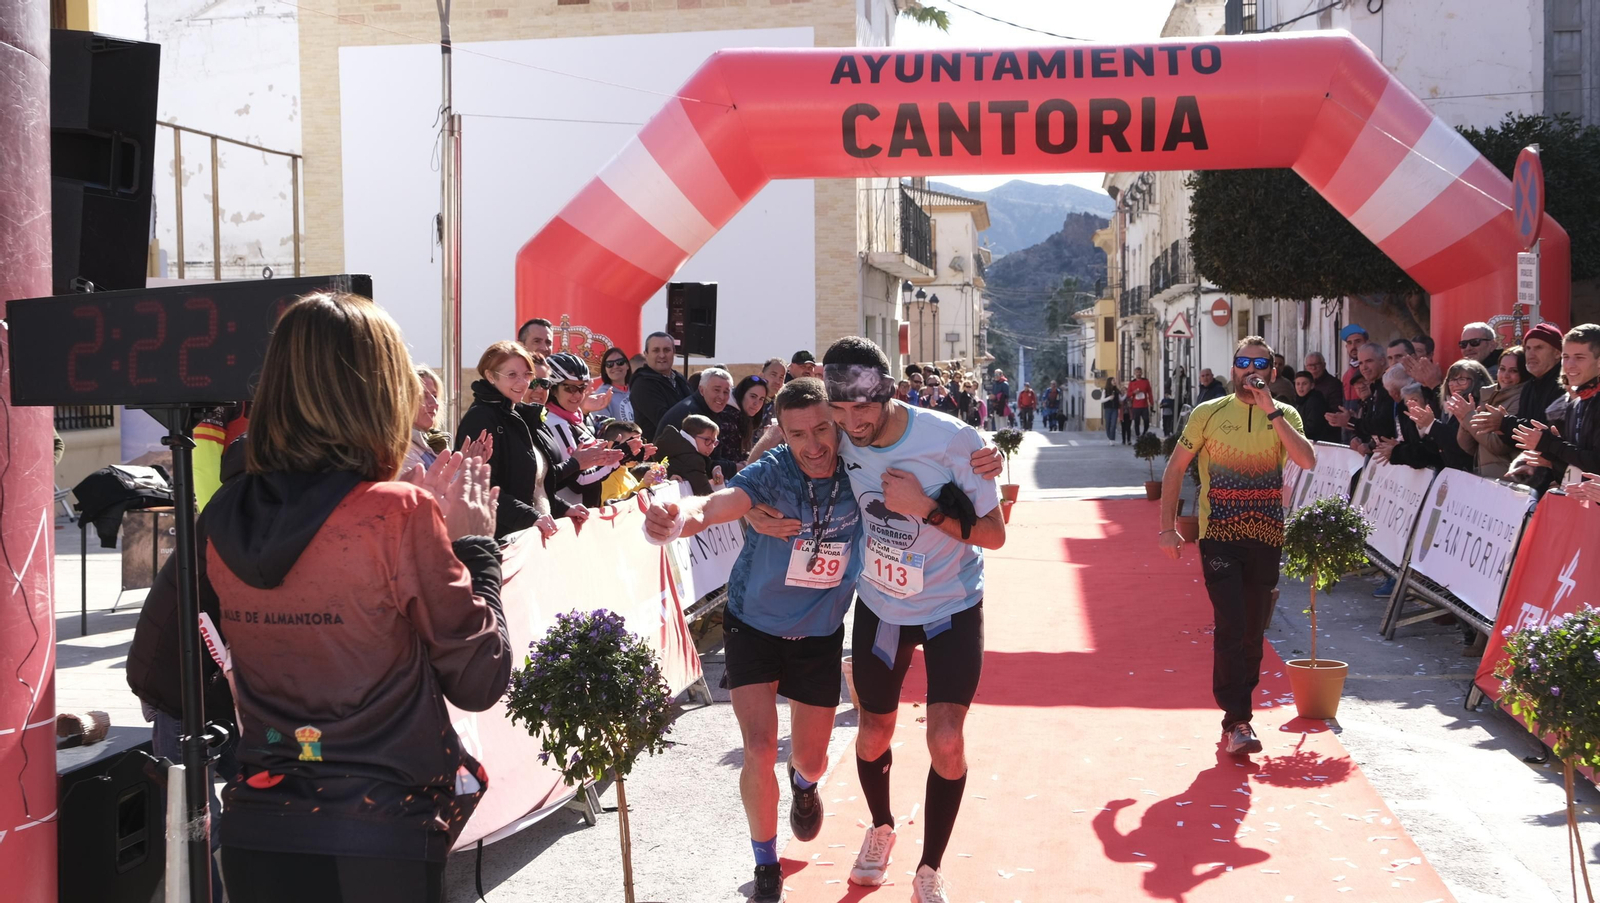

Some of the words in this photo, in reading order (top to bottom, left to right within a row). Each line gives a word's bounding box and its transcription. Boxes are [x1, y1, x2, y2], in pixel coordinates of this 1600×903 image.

[830, 44, 1222, 84] AYUNTAMIENTO
[841, 95, 1209, 159] CANTORIA
[876, 528, 913, 541] CARRASCA
[1446, 500, 1504, 537] AYUNTAMIENTO
[1503, 523, 1515, 543] DE
[812, 547, 840, 556] PLVORA
[1433, 519, 1508, 585] CANTORIA
[874, 558, 908, 587] 113
[245, 611, 259, 624] DE
[263, 612, 344, 625] ALMANZORA
